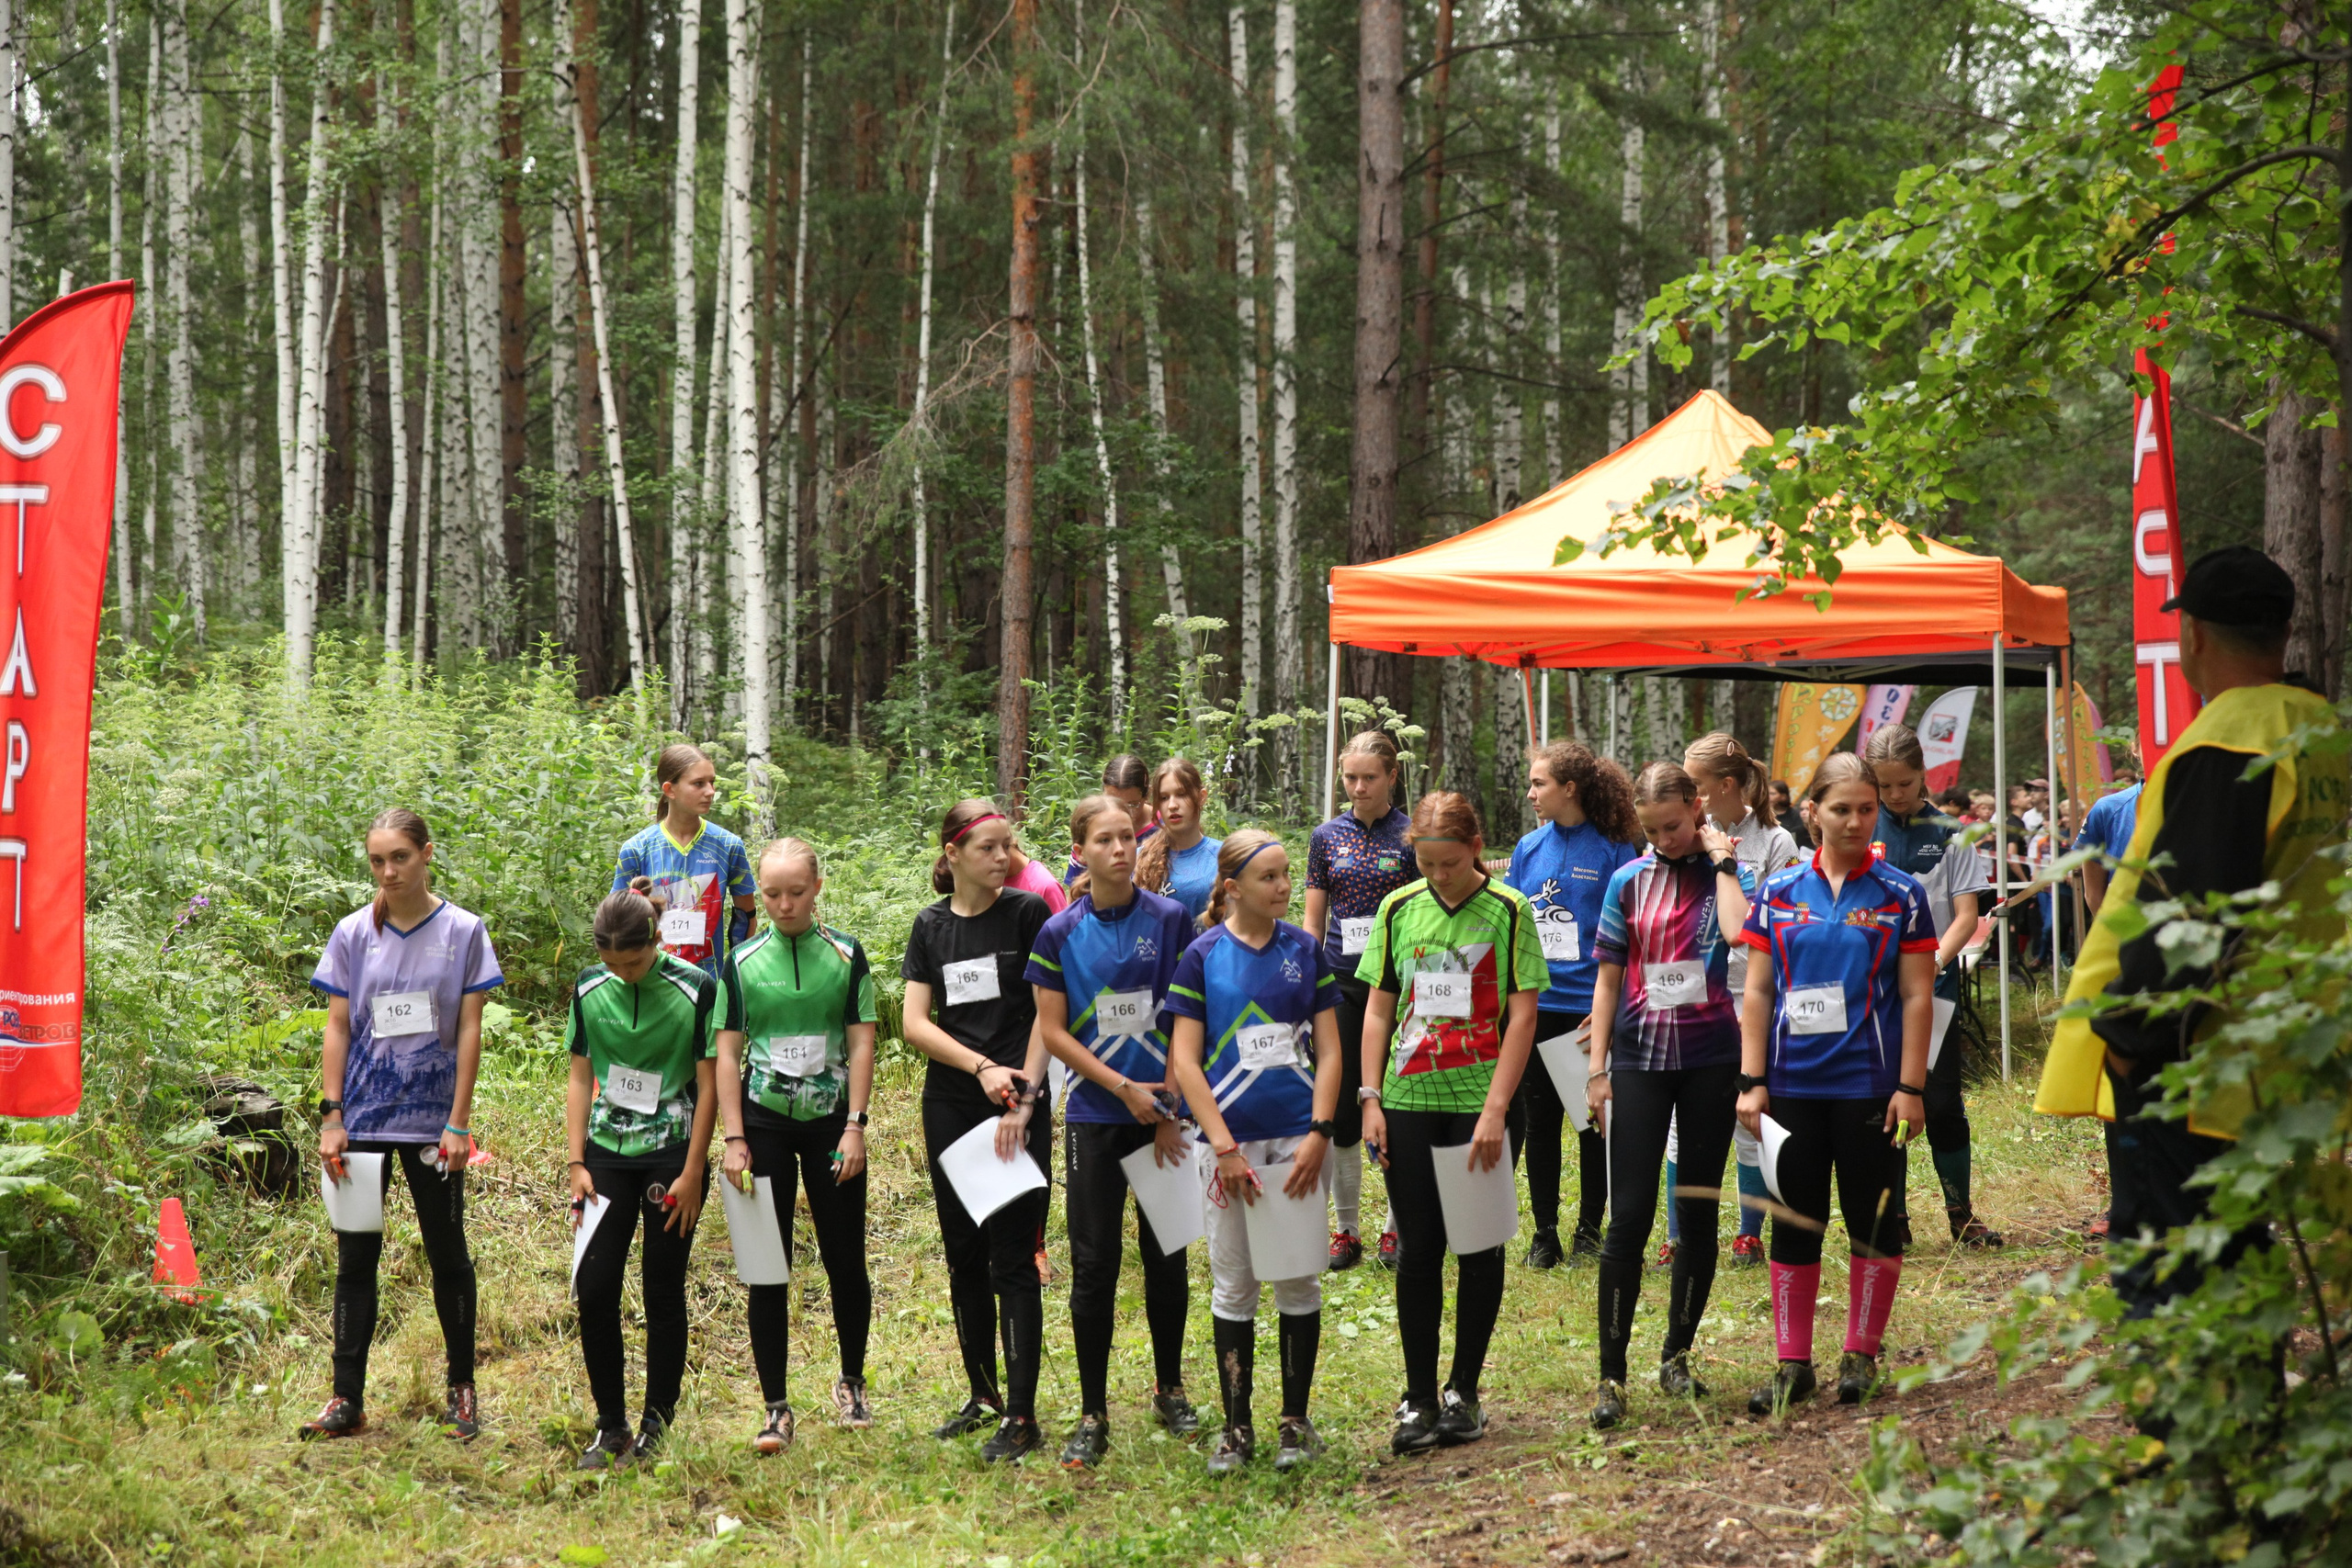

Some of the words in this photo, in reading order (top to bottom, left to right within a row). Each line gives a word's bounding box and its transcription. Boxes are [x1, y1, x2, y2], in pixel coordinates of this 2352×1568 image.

[0, 362, 67, 932] СТАРТ
[671, 919, 690, 930] 171
[1350, 926, 1370, 937] 175
[1543, 932, 1562, 943] 176
[956, 971, 978, 984] 165
[1658, 973, 1684, 987] 169
[1428, 984, 1452, 997] 168
[387, 1004, 412, 1017] 162
[1111, 1003, 1136, 1016] 166
[1800, 1000, 1825, 1014] 170
[1250, 1035, 1274, 1050] 167
[783, 1047, 808, 1059] 164
[620, 1077, 642, 1092] 163
[1779, 1282, 1790, 1344] NORDSKI
[1857, 1277, 1875, 1337] NORDSKI
